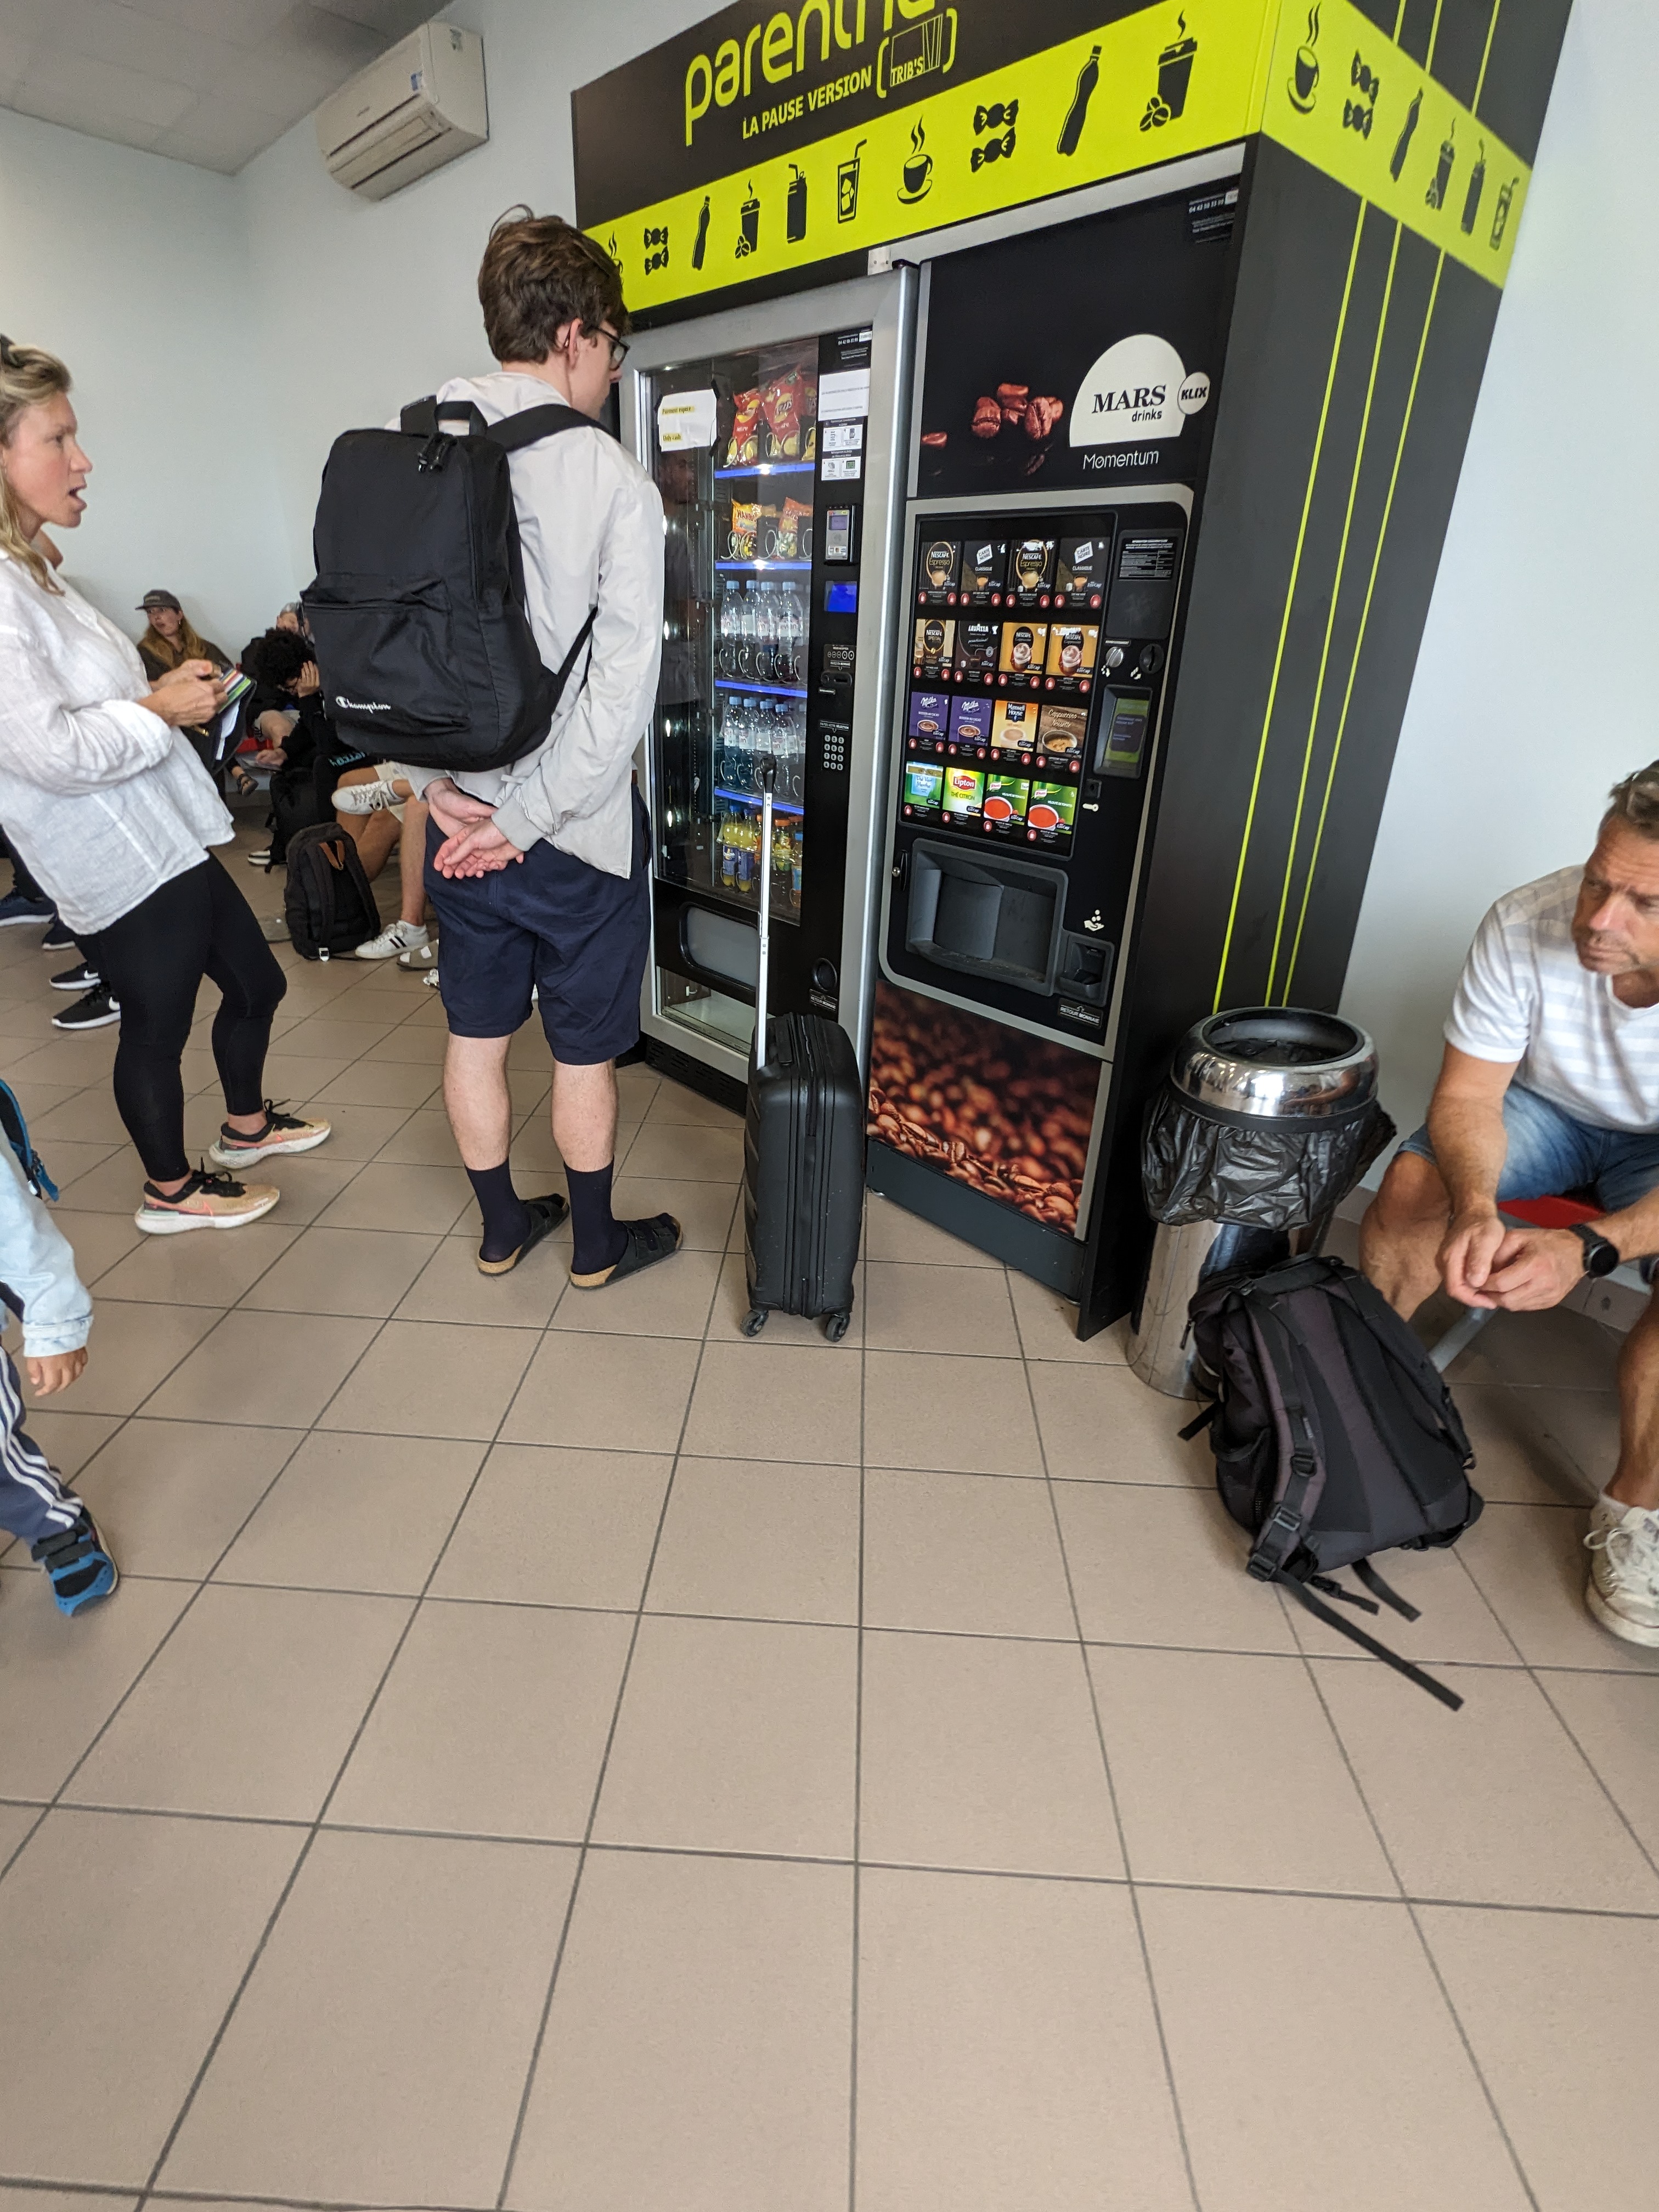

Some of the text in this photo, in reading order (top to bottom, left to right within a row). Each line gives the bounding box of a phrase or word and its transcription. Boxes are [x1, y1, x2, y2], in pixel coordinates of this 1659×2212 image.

[891, 56, 924, 85] TRIB'S
[743, 65, 872, 140] LA PAUSE VERSION
[1091, 384, 1167, 414] MARS
[1181, 386, 1207, 401] KLIX
[1131, 408, 1163, 423] drinks
[929, 558, 950, 566] Espresso
[335, 695, 392, 714] Champion
[921, 696, 937, 707] Milka
[962, 701, 979, 712] Milka
[1007, 703, 1025, 712] Maxwell
[1048, 709, 1077, 719] Cappuccino
[1052, 720, 1071, 729] Noisette
[953, 777, 974, 788] Lipton
